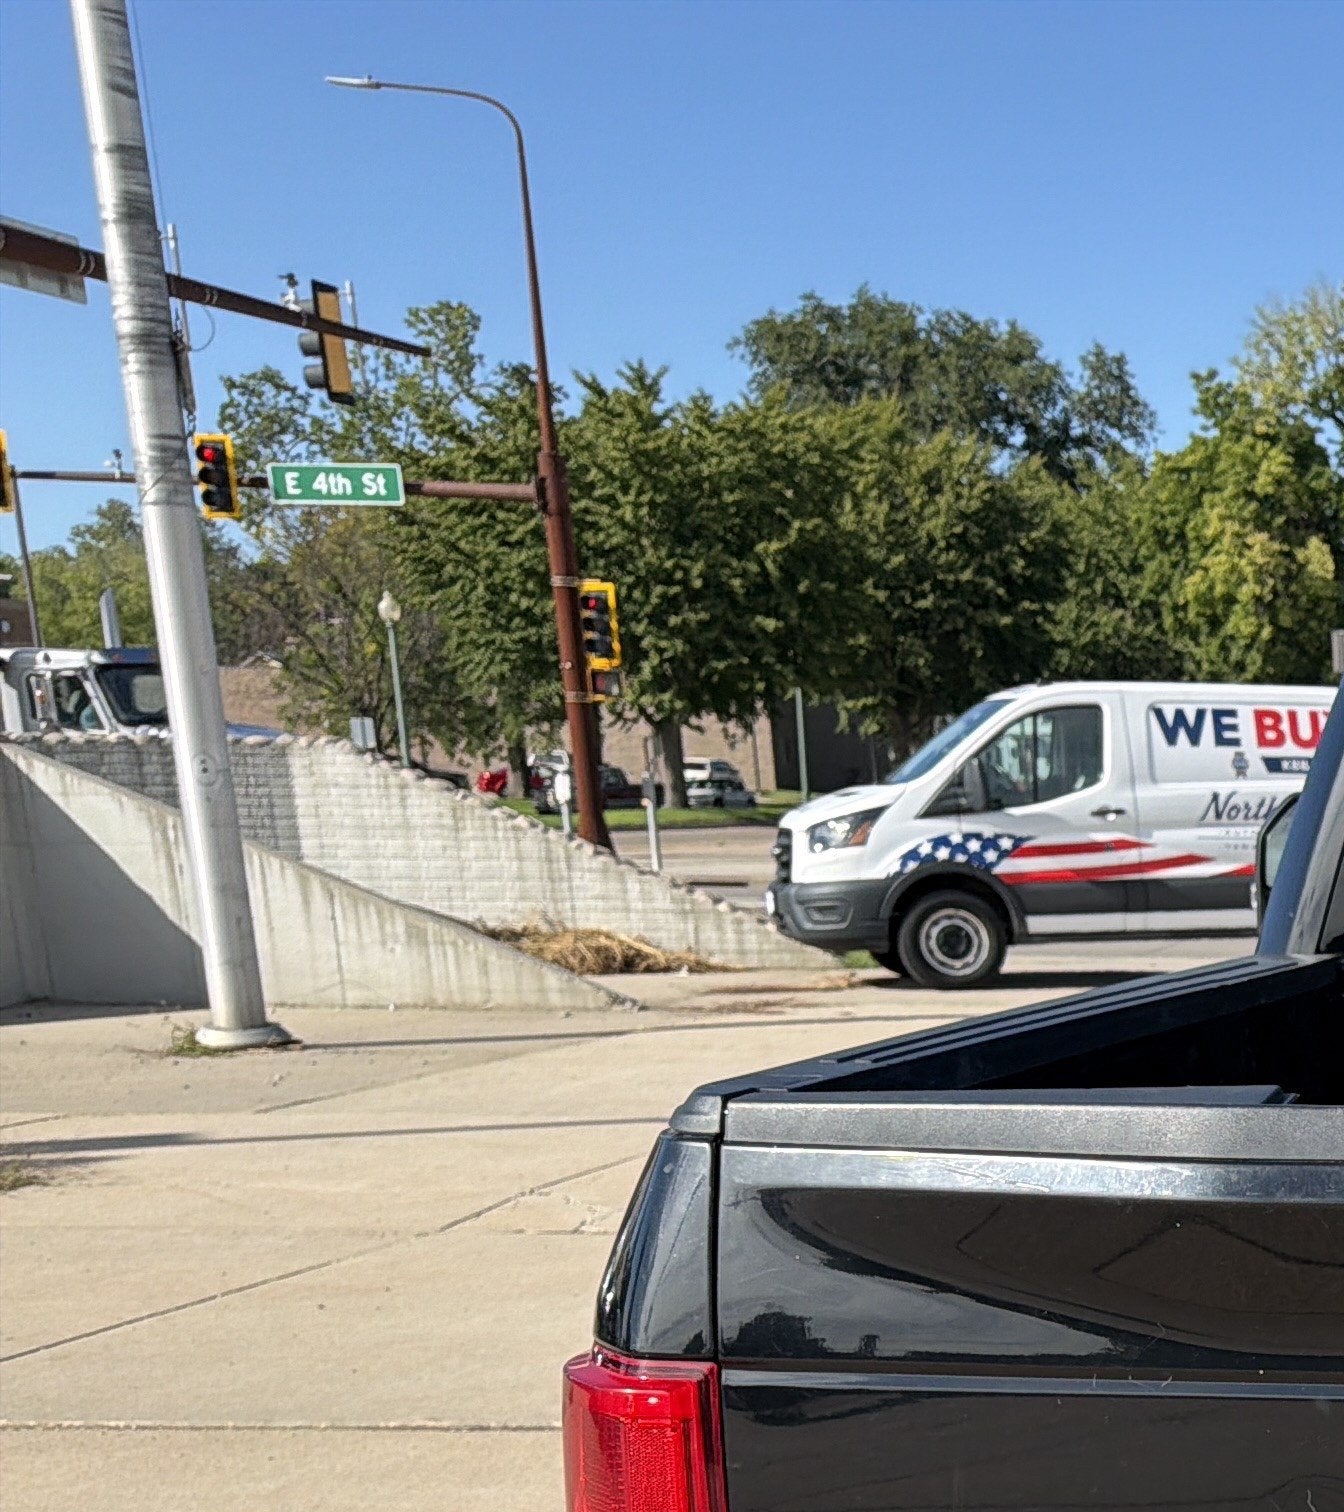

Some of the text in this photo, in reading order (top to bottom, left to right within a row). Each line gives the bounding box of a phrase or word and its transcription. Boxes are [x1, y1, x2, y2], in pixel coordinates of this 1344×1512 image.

[284, 472, 388, 496] E 4th St
[1153, 707, 1331, 749] WE BU
